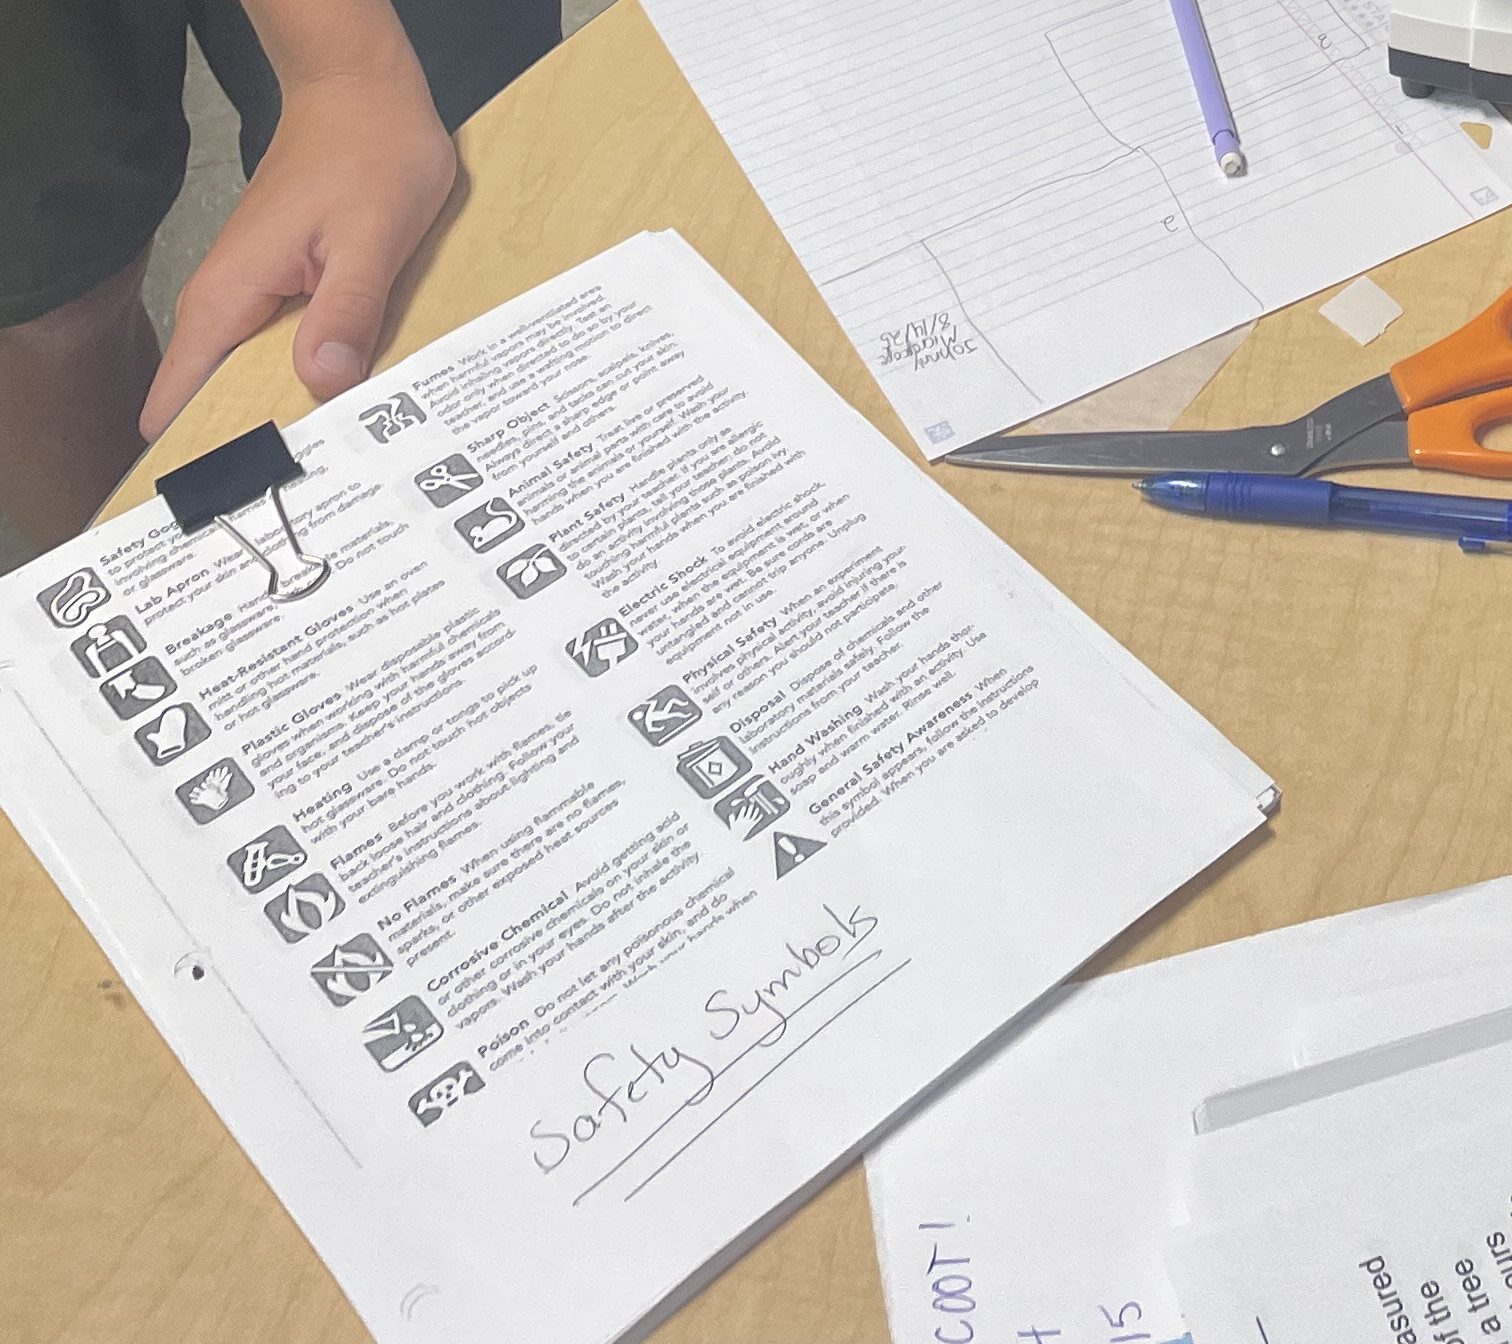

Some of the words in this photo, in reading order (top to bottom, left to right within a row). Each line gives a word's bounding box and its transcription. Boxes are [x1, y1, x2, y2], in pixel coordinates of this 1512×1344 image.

[411, 365, 455, 392] Fumes
[466, 429, 505, 454] Sharp
[506, 402, 551, 429] Object
[508, 465, 553, 499] Animal
[552, 443, 593, 470] Safety
[548, 519, 584, 544] Plant
[583, 492, 625, 521] Safety
[99, 537, 145, 567] Safety
[134, 595, 163, 615] Lab
[167, 568, 210, 599] Apron
[618, 582, 669, 618] Electric
[667, 555, 710, 585] Shock
[164, 613, 233, 656] Breakage
[198, 634, 303, 701] Heat-Resistant
[304, 605, 354, 637] Gloves
[682, 643, 736, 684] Physical
[735, 616, 777, 648] Safety
[241, 723, 290, 755] Plastic
[291, 692, 342, 725] Gloves
[729, 689, 787, 734] Disposal
[767, 743, 806, 775] Hand
[804, 704, 869, 746] Washing
[808, 771, 863, 815] General
[862, 741, 905, 776] Safety
[906, 692, 973, 745] Awareness
[329, 832, 383, 871] Flames
[376, 912, 402, 932] No
[403, 874, 457, 914] Flames
[426, 941, 499, 992] Corrosive
[500, 890, 569, 942] Chemical
[531, 1040, 716, 1174] Safety
[705, 901, 880, 1048] Symbols
